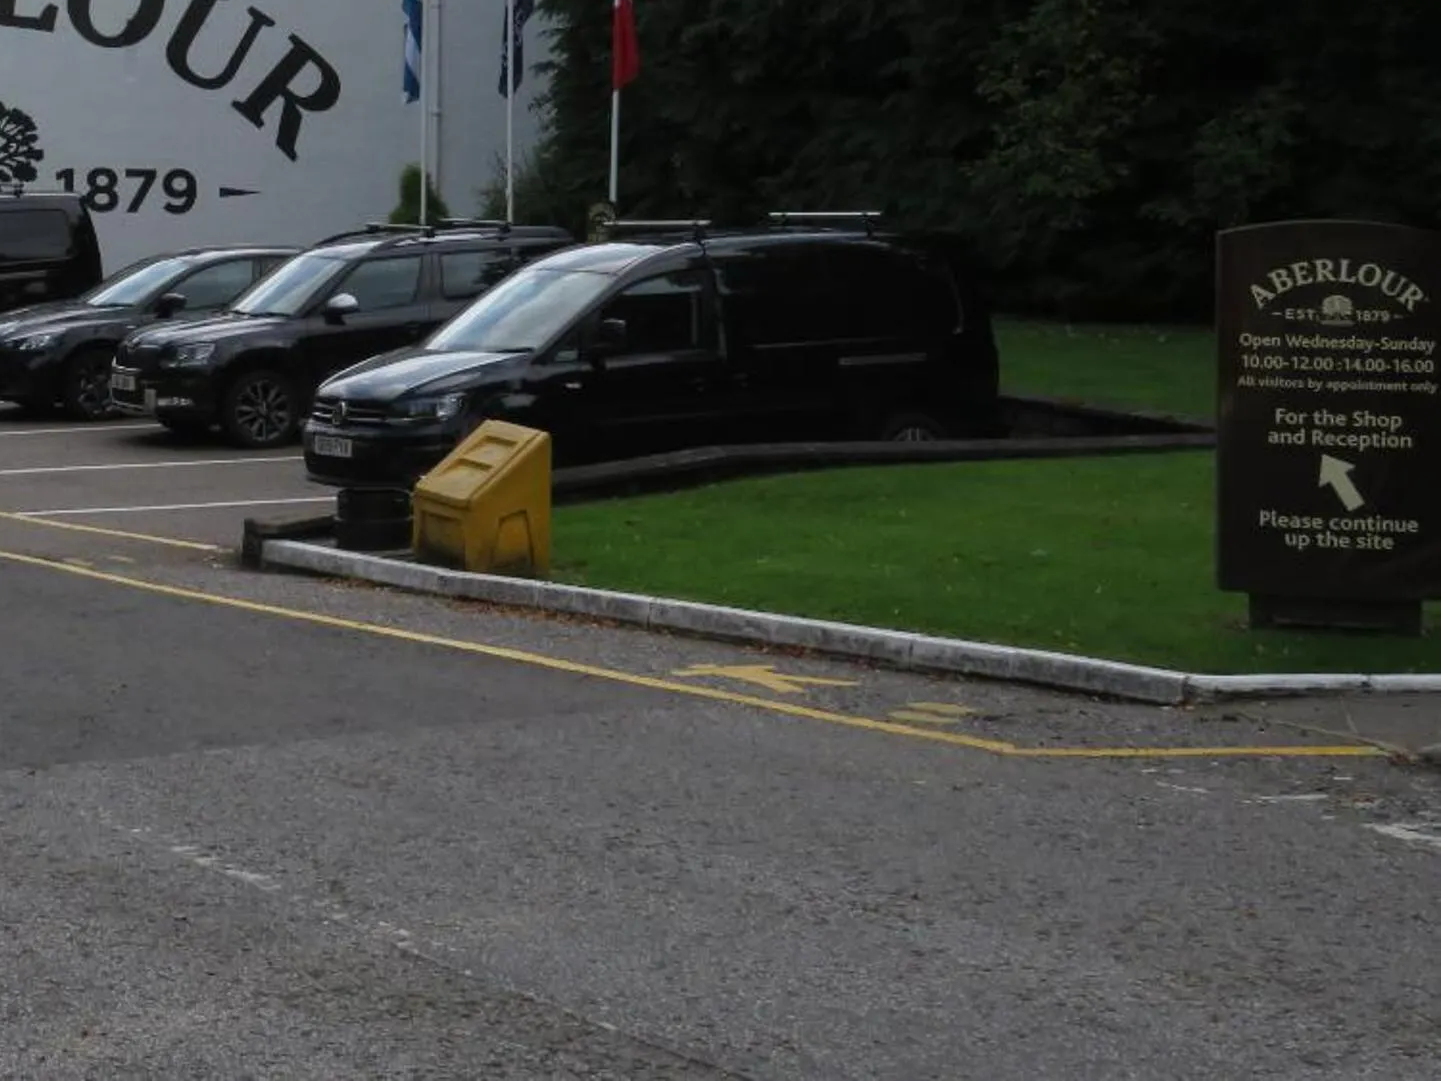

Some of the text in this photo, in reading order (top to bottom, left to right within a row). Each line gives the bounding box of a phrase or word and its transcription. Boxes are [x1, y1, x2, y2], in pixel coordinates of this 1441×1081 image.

[56, 167, 197, 214] 1879
[1249, 258, 1425, 311] ABERLOUR
[1355, 309, 1390, 322] 1879
[1239, 332, 1435, 355] Open Wednesday-Sunday
[1237, 375, 1438, 395] All visitors by appointment only
[1274, 408, 1402, 432] For the Shop
[1268, 427, 1412, 452] and Reception
[1260, 509, 1419, 533] Please continue
[1284, 531, 1395, 551] up the site
